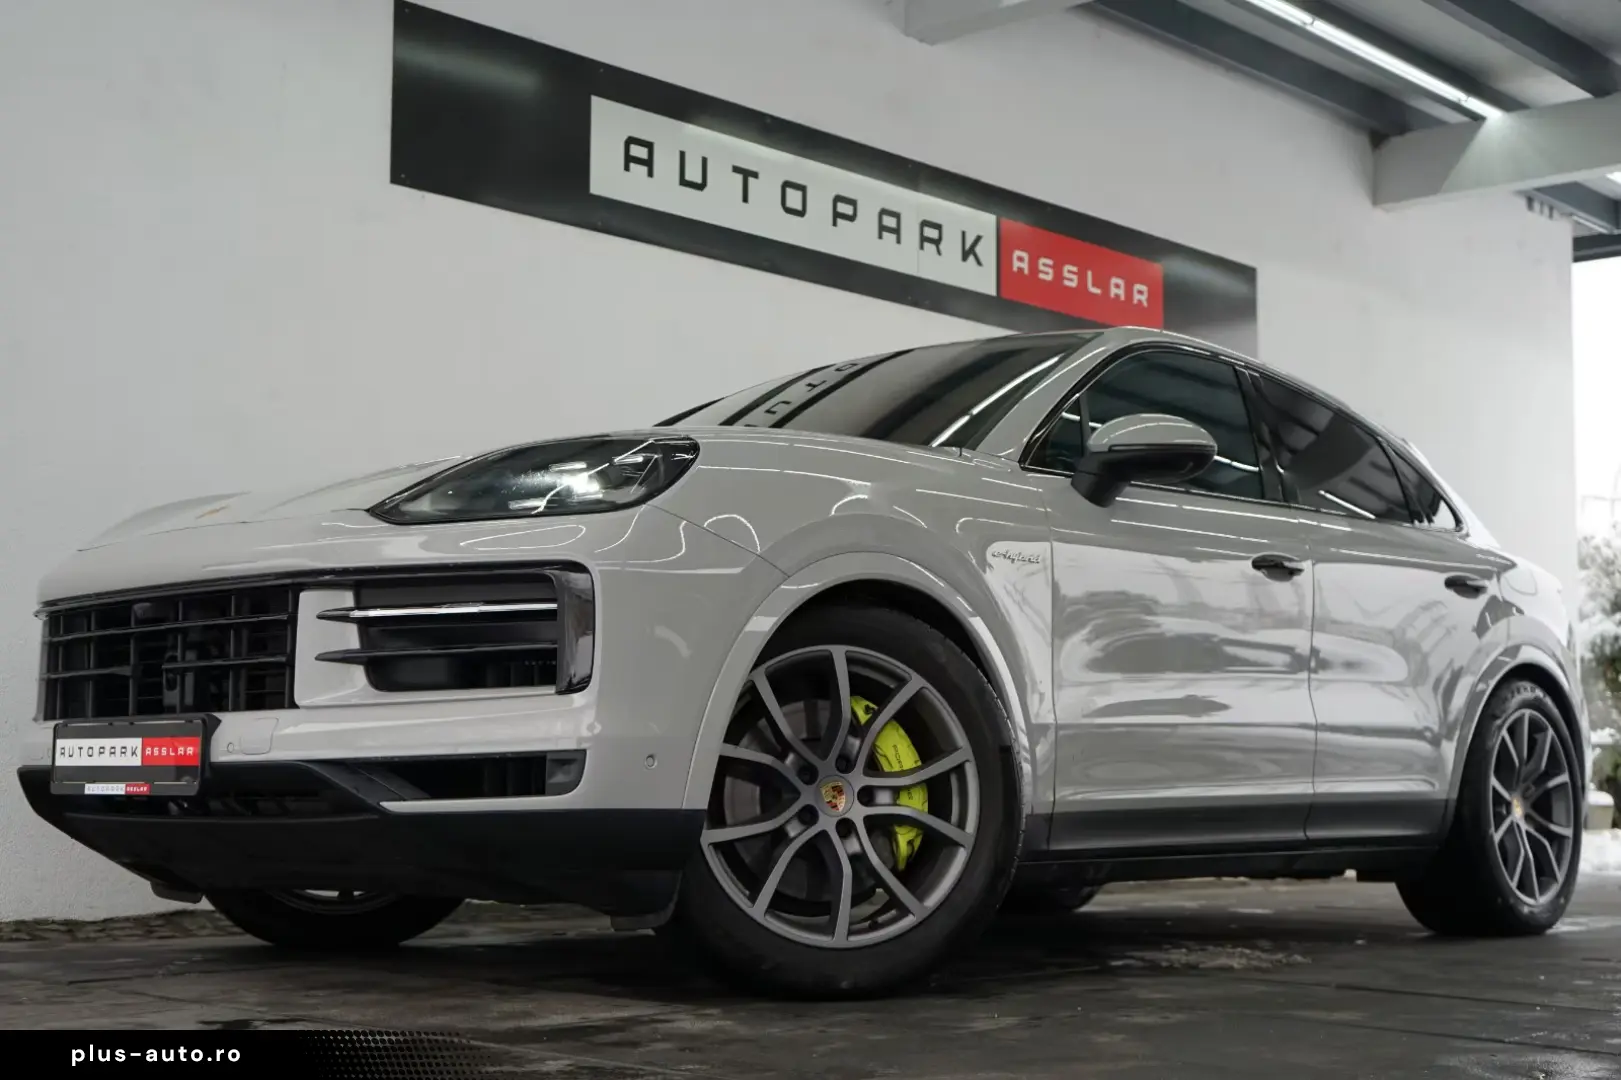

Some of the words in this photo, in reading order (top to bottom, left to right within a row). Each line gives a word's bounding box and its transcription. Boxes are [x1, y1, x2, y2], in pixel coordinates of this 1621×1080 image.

[623, 135, 984, 267] AUTOPARK
[1012, 249, 1149, 308] ASSLAR
[60, 746, 138, 758] AUTOPARK
[145, 747, 194, 756] ASSLAR
